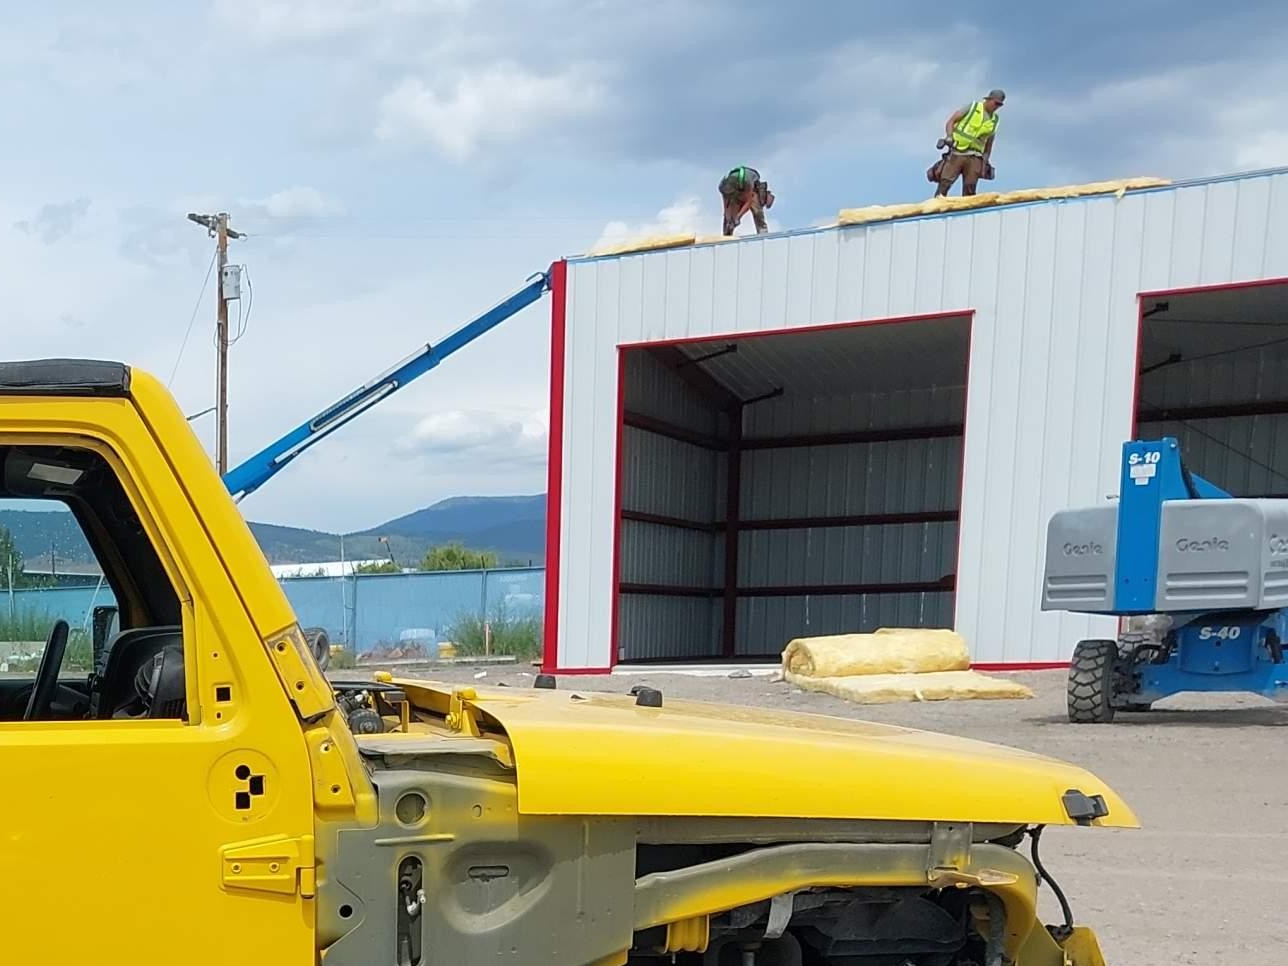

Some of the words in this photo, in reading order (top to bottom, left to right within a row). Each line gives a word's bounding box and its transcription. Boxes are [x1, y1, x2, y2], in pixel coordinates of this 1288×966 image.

[1062, 541, 1103, 556] Genie
[1175, 535, 1231, 553] Genie
[1198, 625, 1241, 641] S-40
